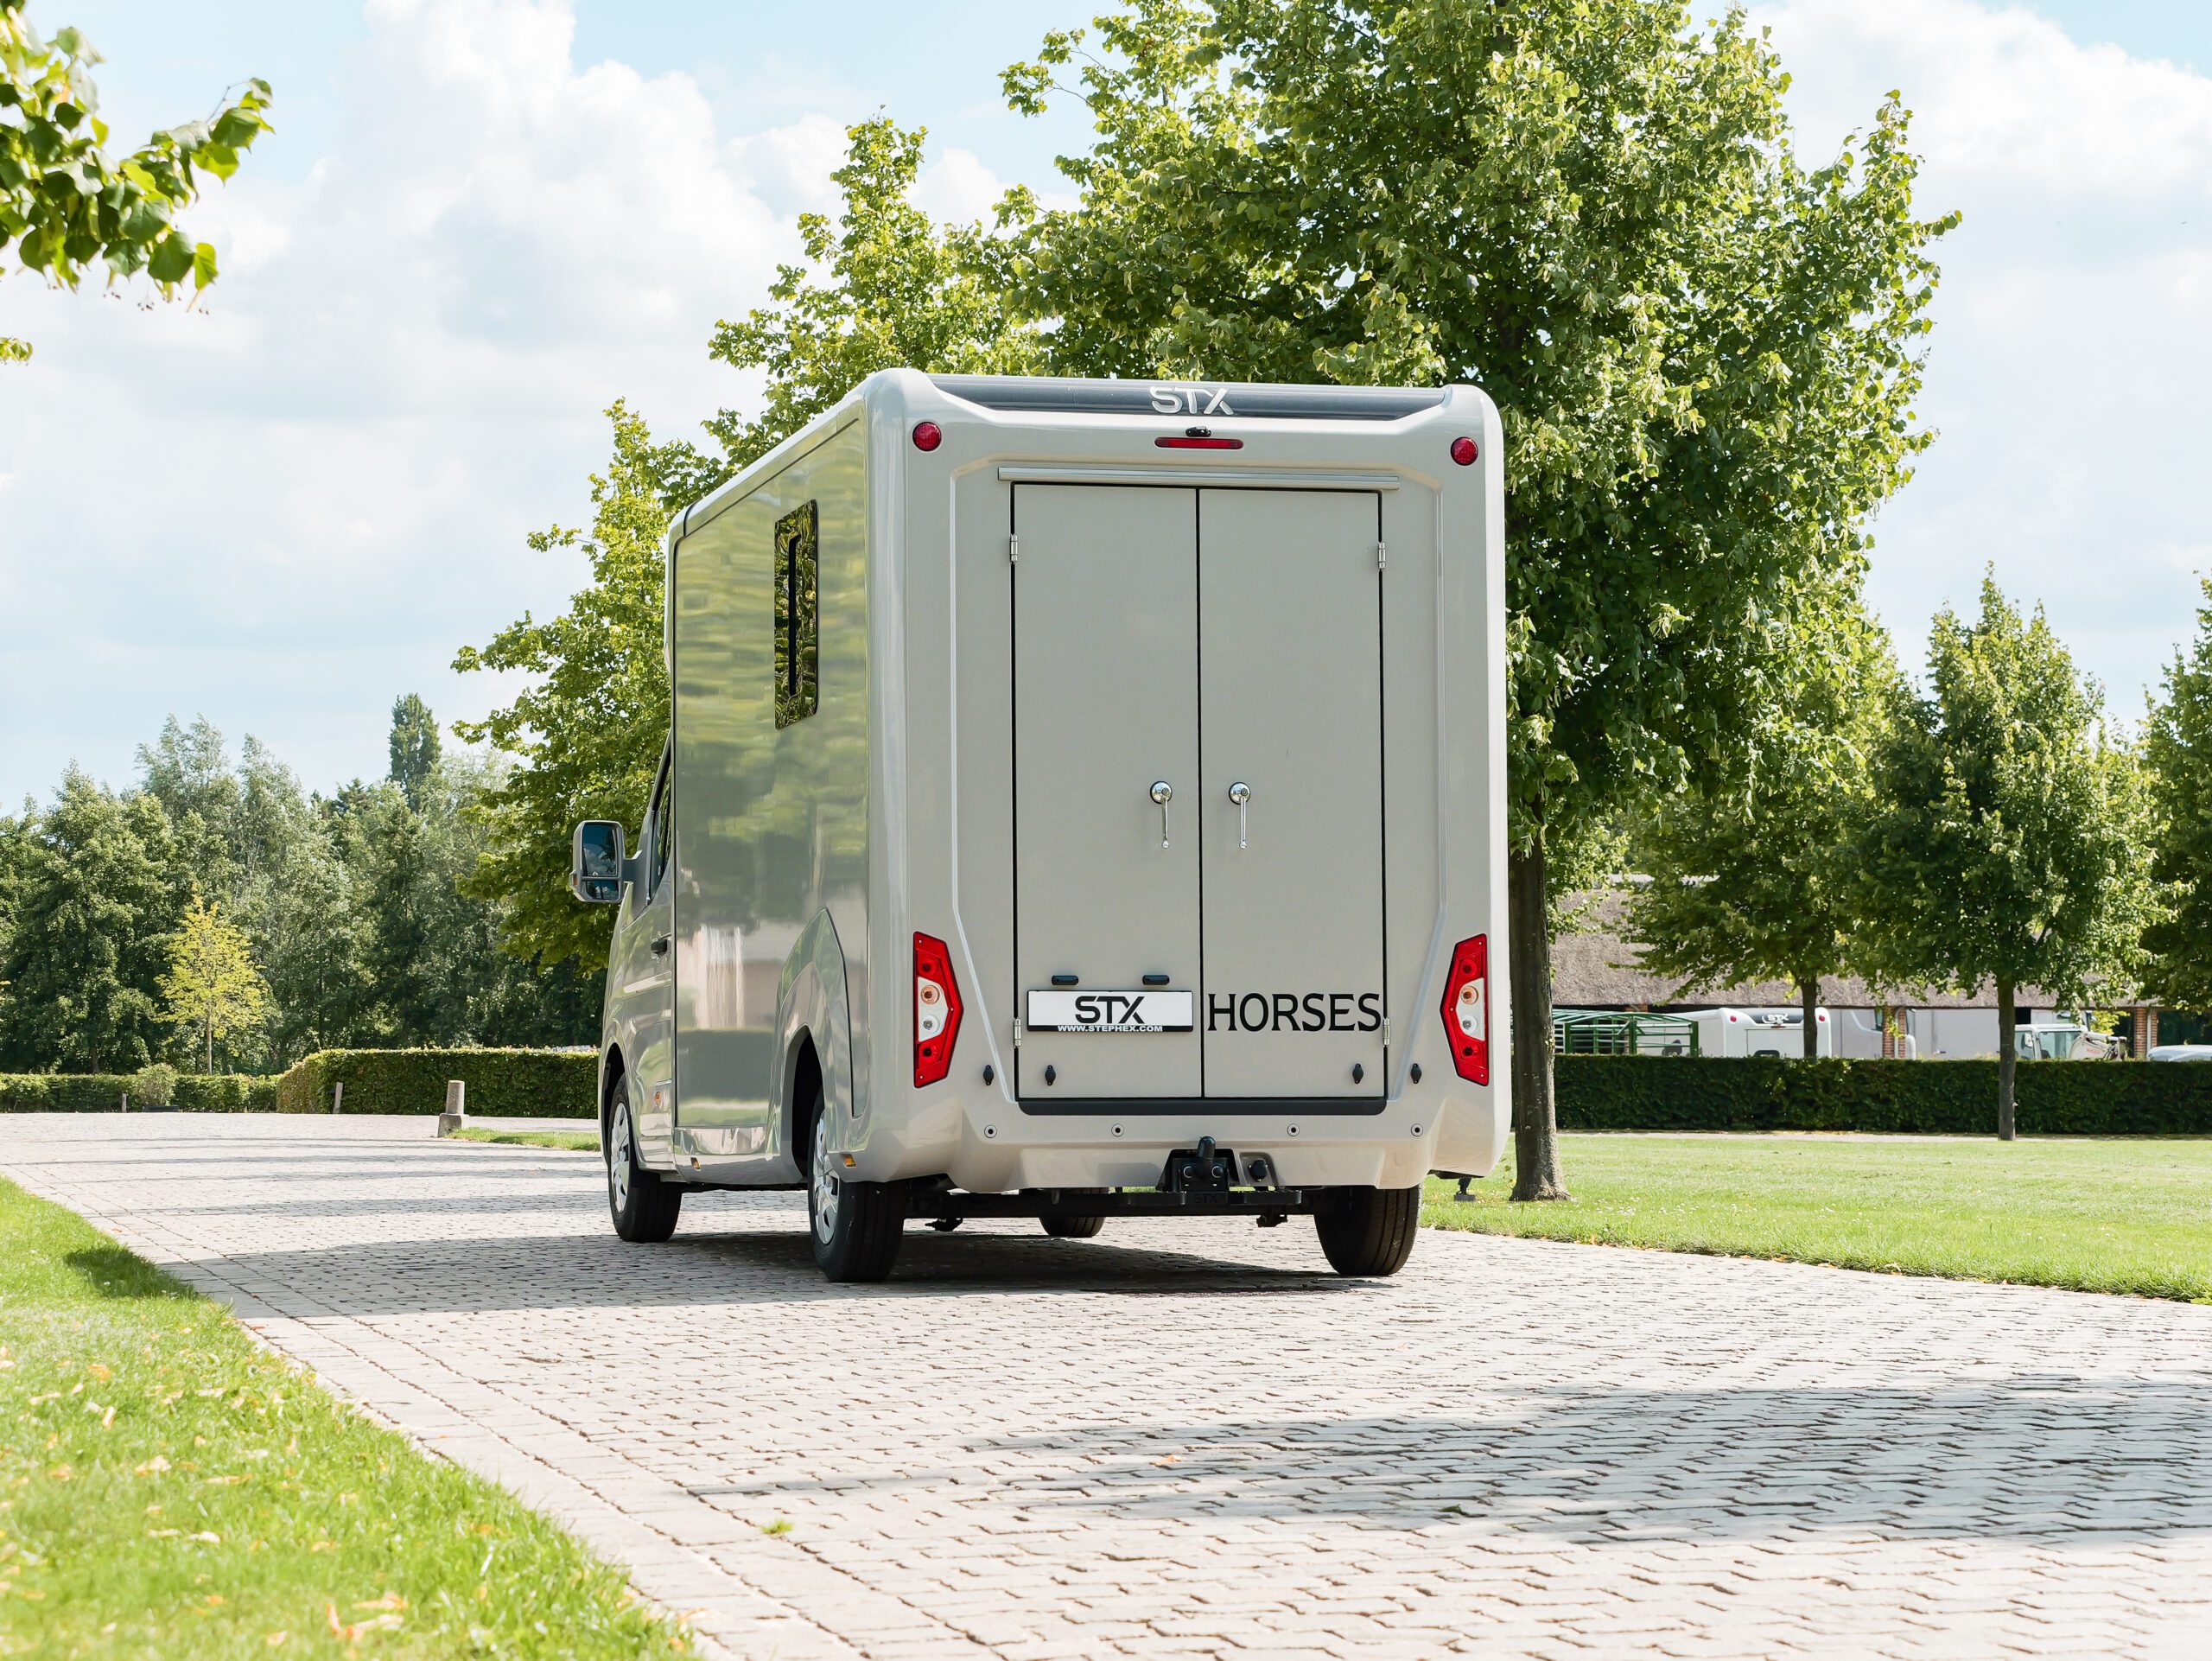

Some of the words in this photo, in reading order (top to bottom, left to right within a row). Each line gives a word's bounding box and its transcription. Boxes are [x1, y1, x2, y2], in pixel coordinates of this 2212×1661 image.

[1149, 386, 1234, 415] STX
[1075, 996, 1145, 1024] STX
[1207, 992, 1382, 1032] HORSES
[1193, 1193, 1217, 1204] STX
